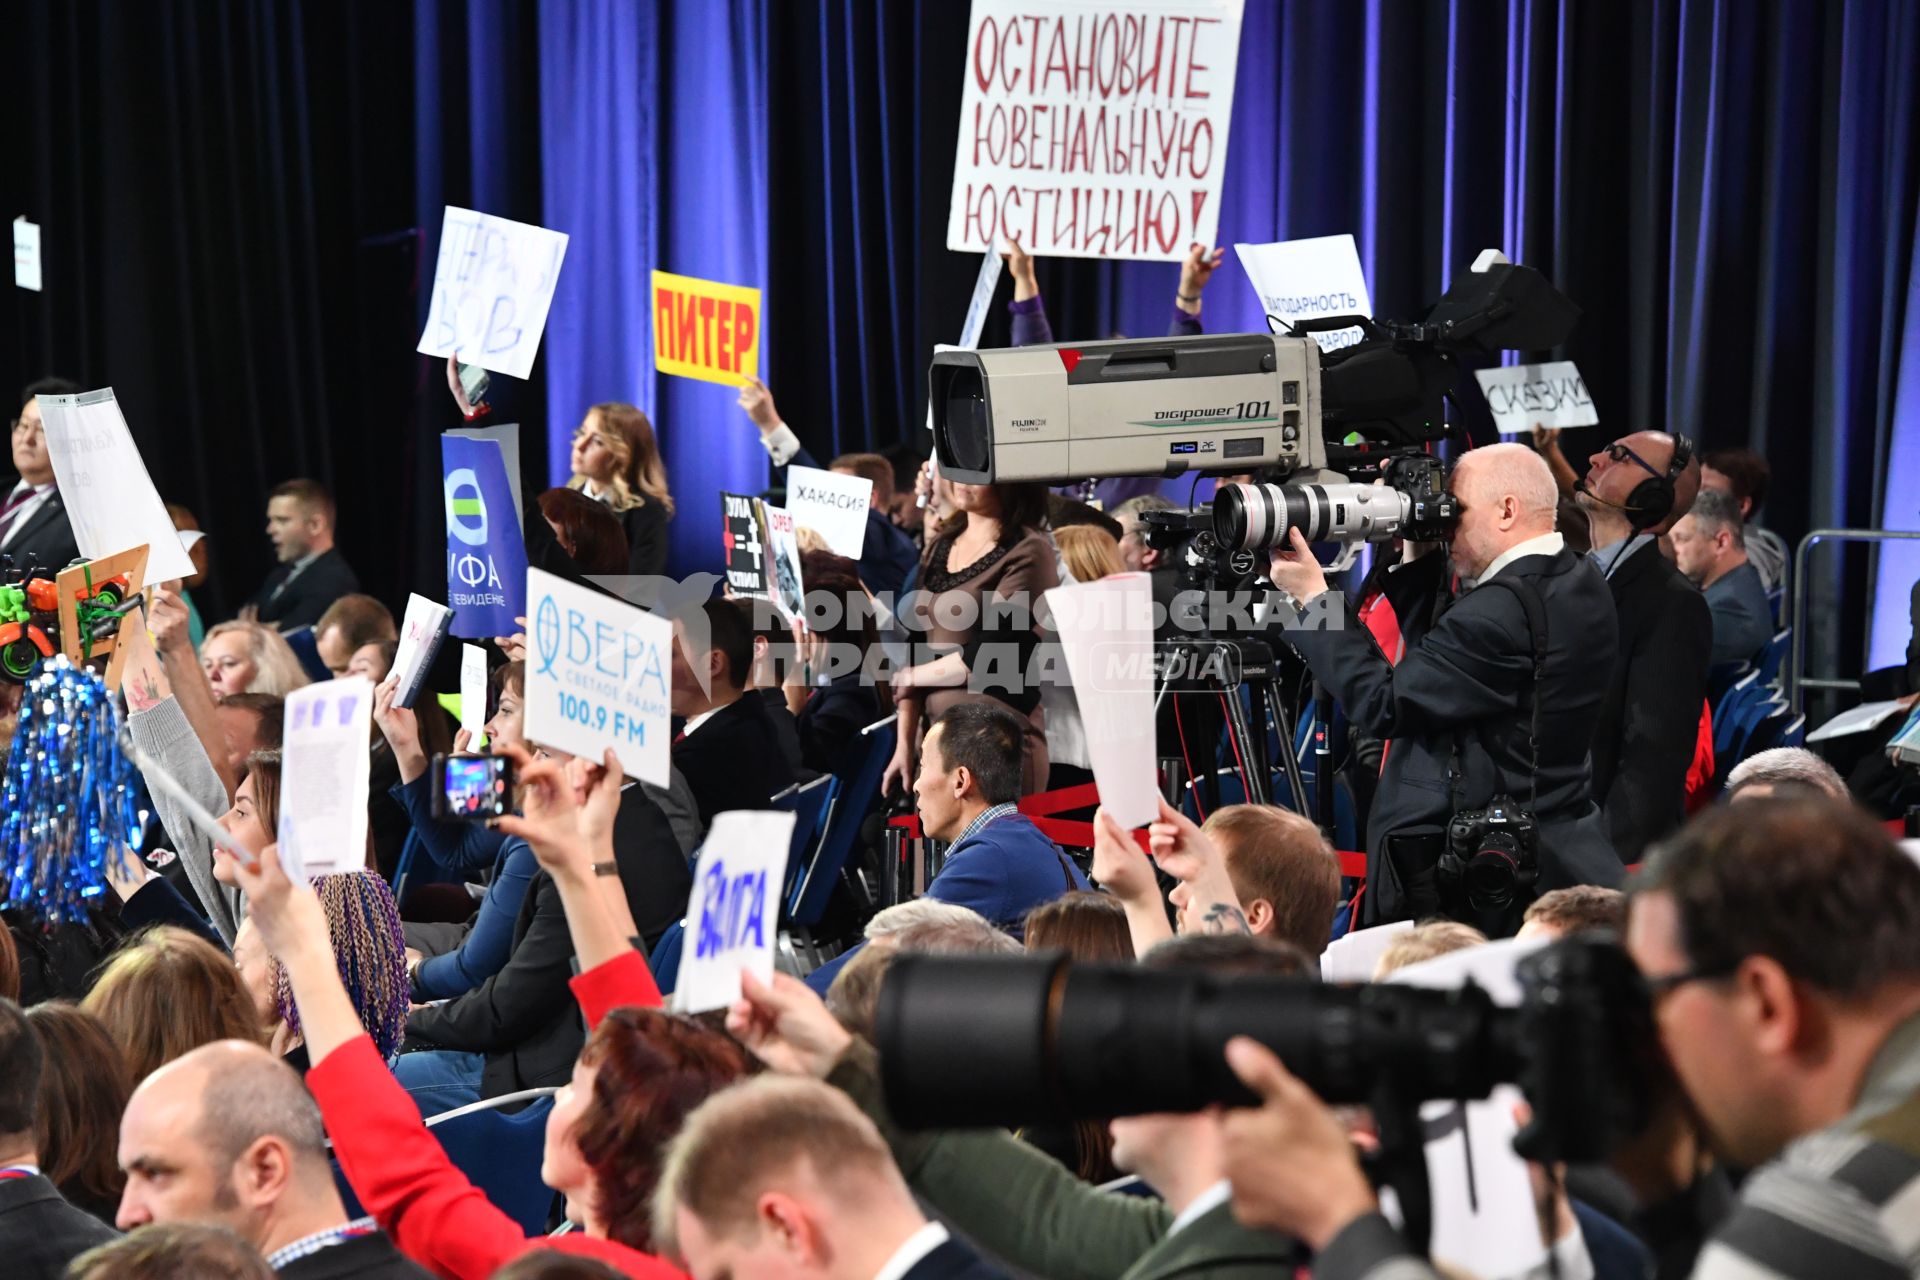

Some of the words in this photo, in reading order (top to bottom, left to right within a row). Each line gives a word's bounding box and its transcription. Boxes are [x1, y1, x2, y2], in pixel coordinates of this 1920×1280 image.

[974, 12, 1222, 100] ОСТАНОВИТЕ
[973, 101, 1213, 180] ЮВЕНАЛЬНУЮ
[964, 183, 1208, 255] ЮСТИЦИЮ!
[656, 287, 755, 374] ПИТЕР
[1316, 330, 1364, 348] НАРОД
[1235, 400, 1271, 420] 101
[1487, 376, 1592, 415] СКАЗКИ
[796, 485, 865, 512] ХАКАСИЯ
[566, 608, 667, 697] ВЕРА
[558, 691, 608, 731] 100.9
[613, 711, 646, 748] FM
